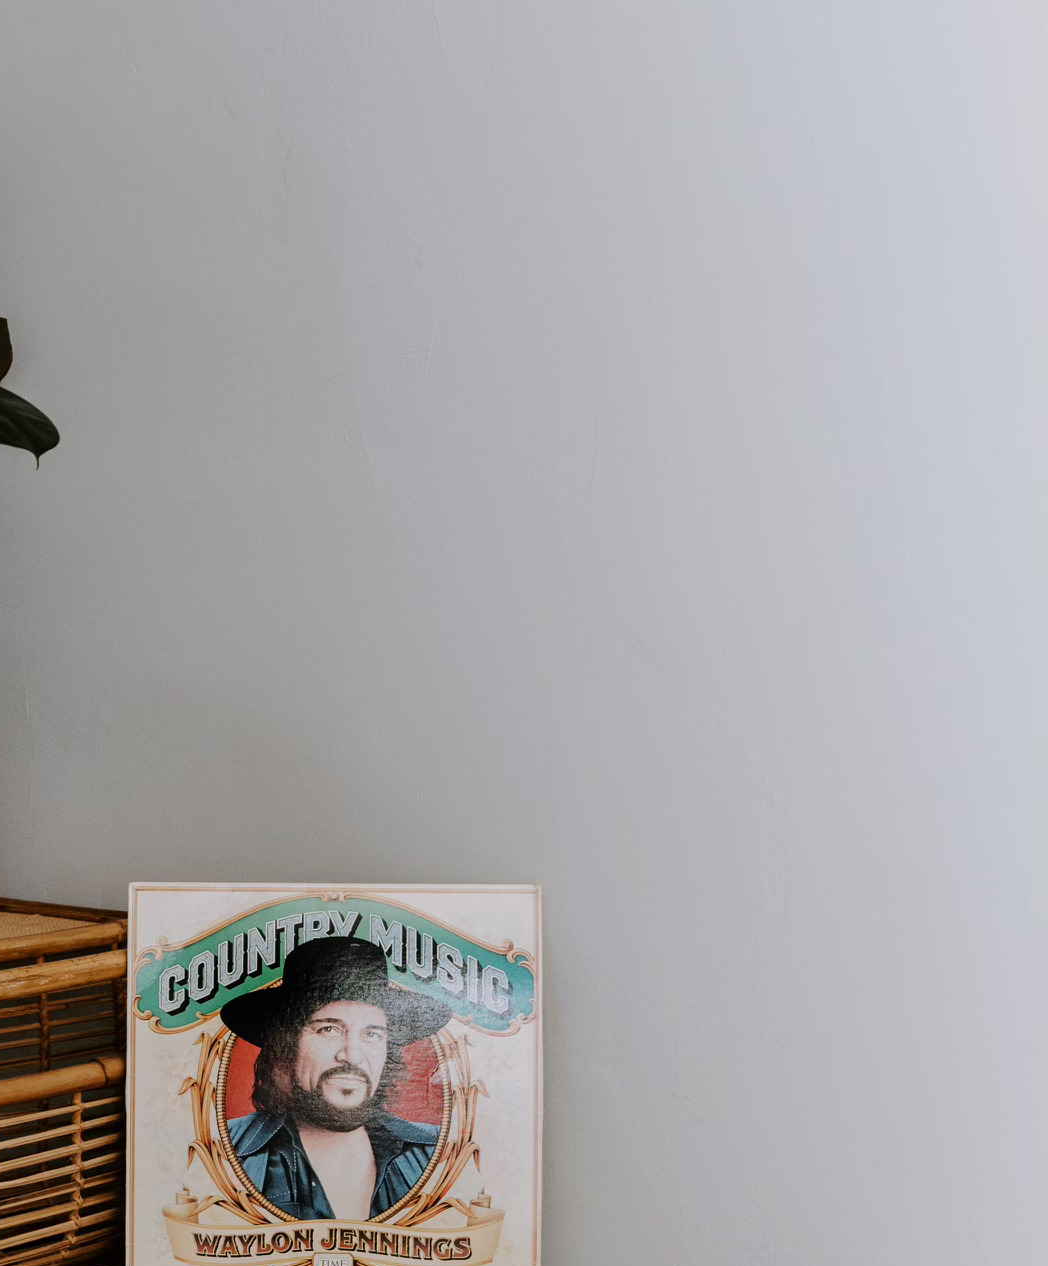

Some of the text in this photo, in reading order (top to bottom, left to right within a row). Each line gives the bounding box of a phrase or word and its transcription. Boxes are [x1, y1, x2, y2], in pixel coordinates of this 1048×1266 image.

[158, 911, 512, 1016] COUNTRY MUSIC
[193, 1228, 472, 1260] WAYLON JENNINGS
